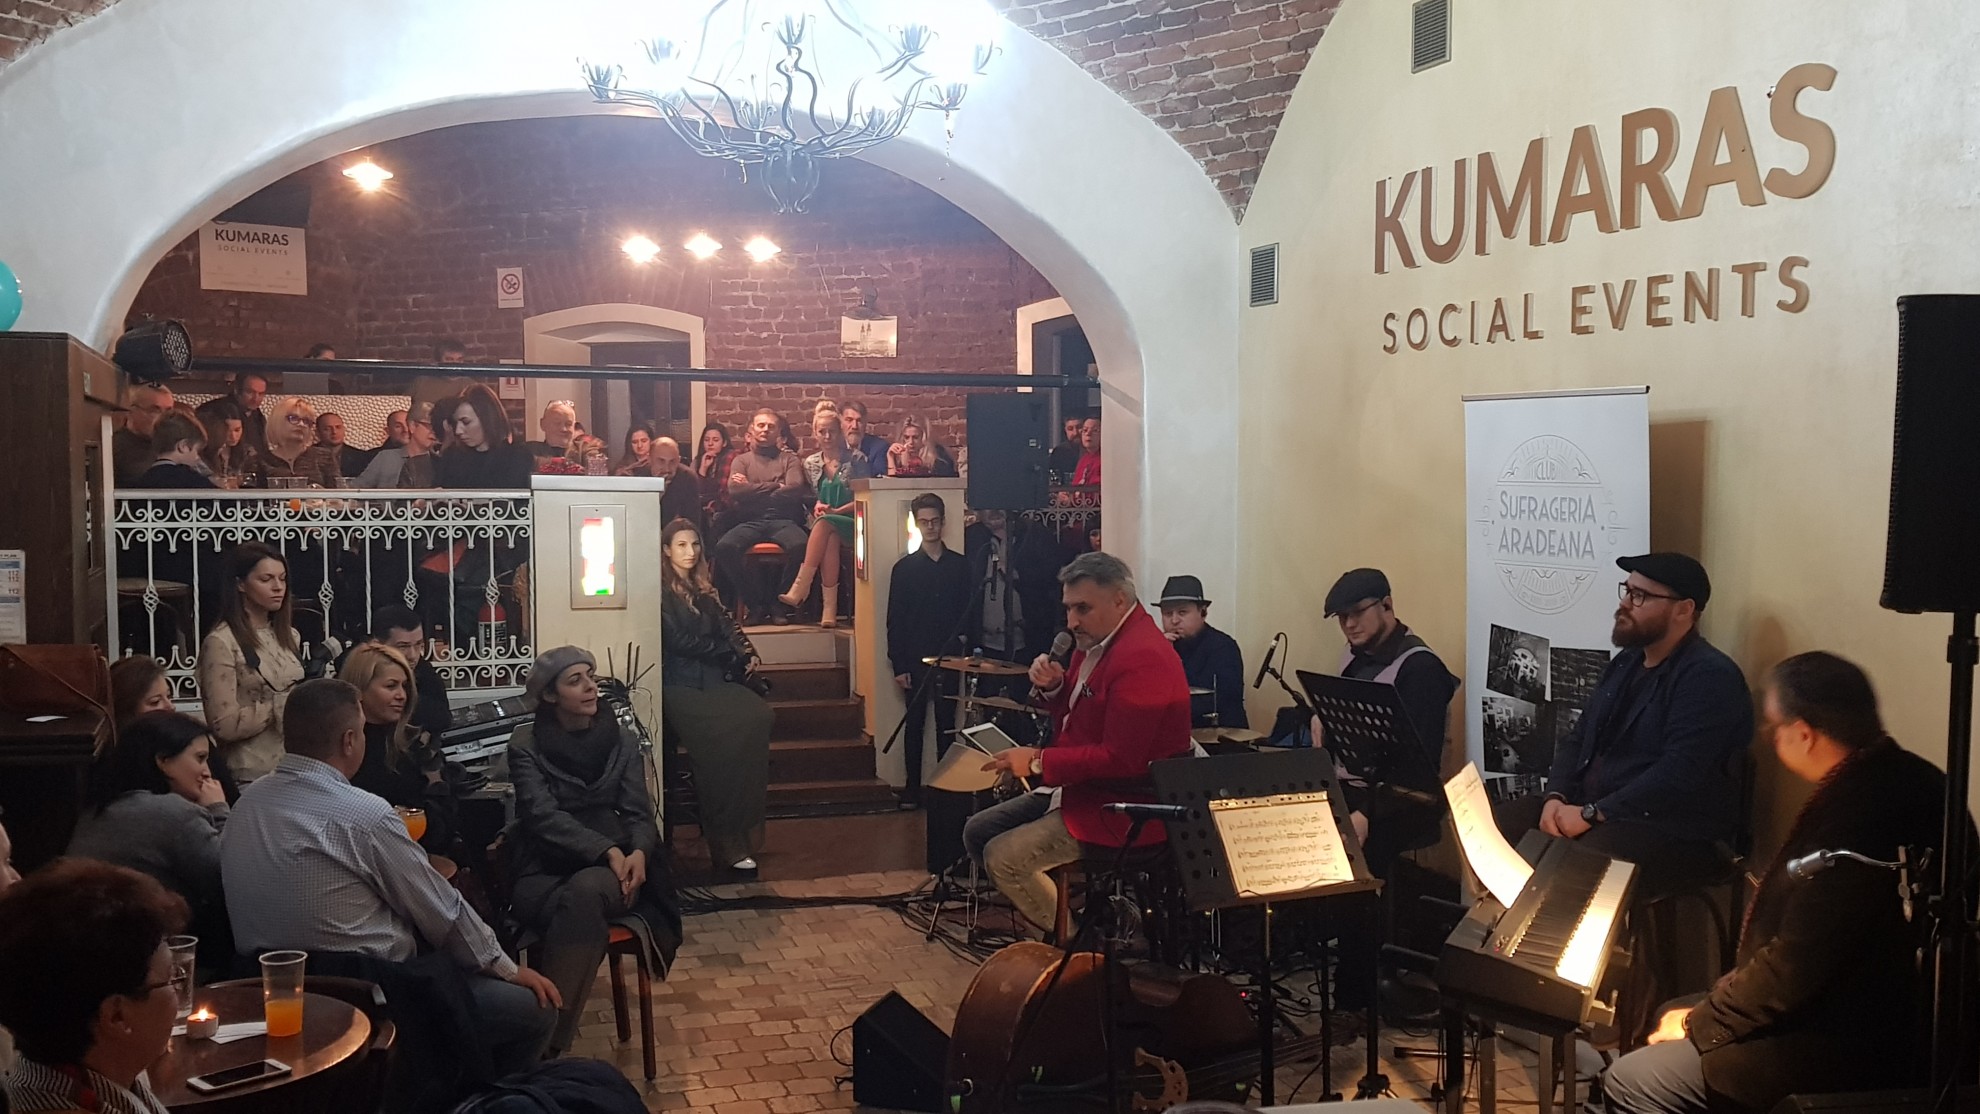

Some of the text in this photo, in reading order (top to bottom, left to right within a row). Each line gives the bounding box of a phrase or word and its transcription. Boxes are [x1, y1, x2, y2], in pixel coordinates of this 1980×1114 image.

[1374, 62, 1838, 275] KUMARAS
[214, 228, 290, 246] KUMARAS
[218, 245, 288, 256] SOCIAL EVENTS
[1382, 255, 1811, 355] SOCIAL EVENTS
[1535, 459, 1556, 480] CLUB
[1499, 490, 1597, 524] SUFRAGERIA
[1498, 526, 1595, 560] ARADEANA
